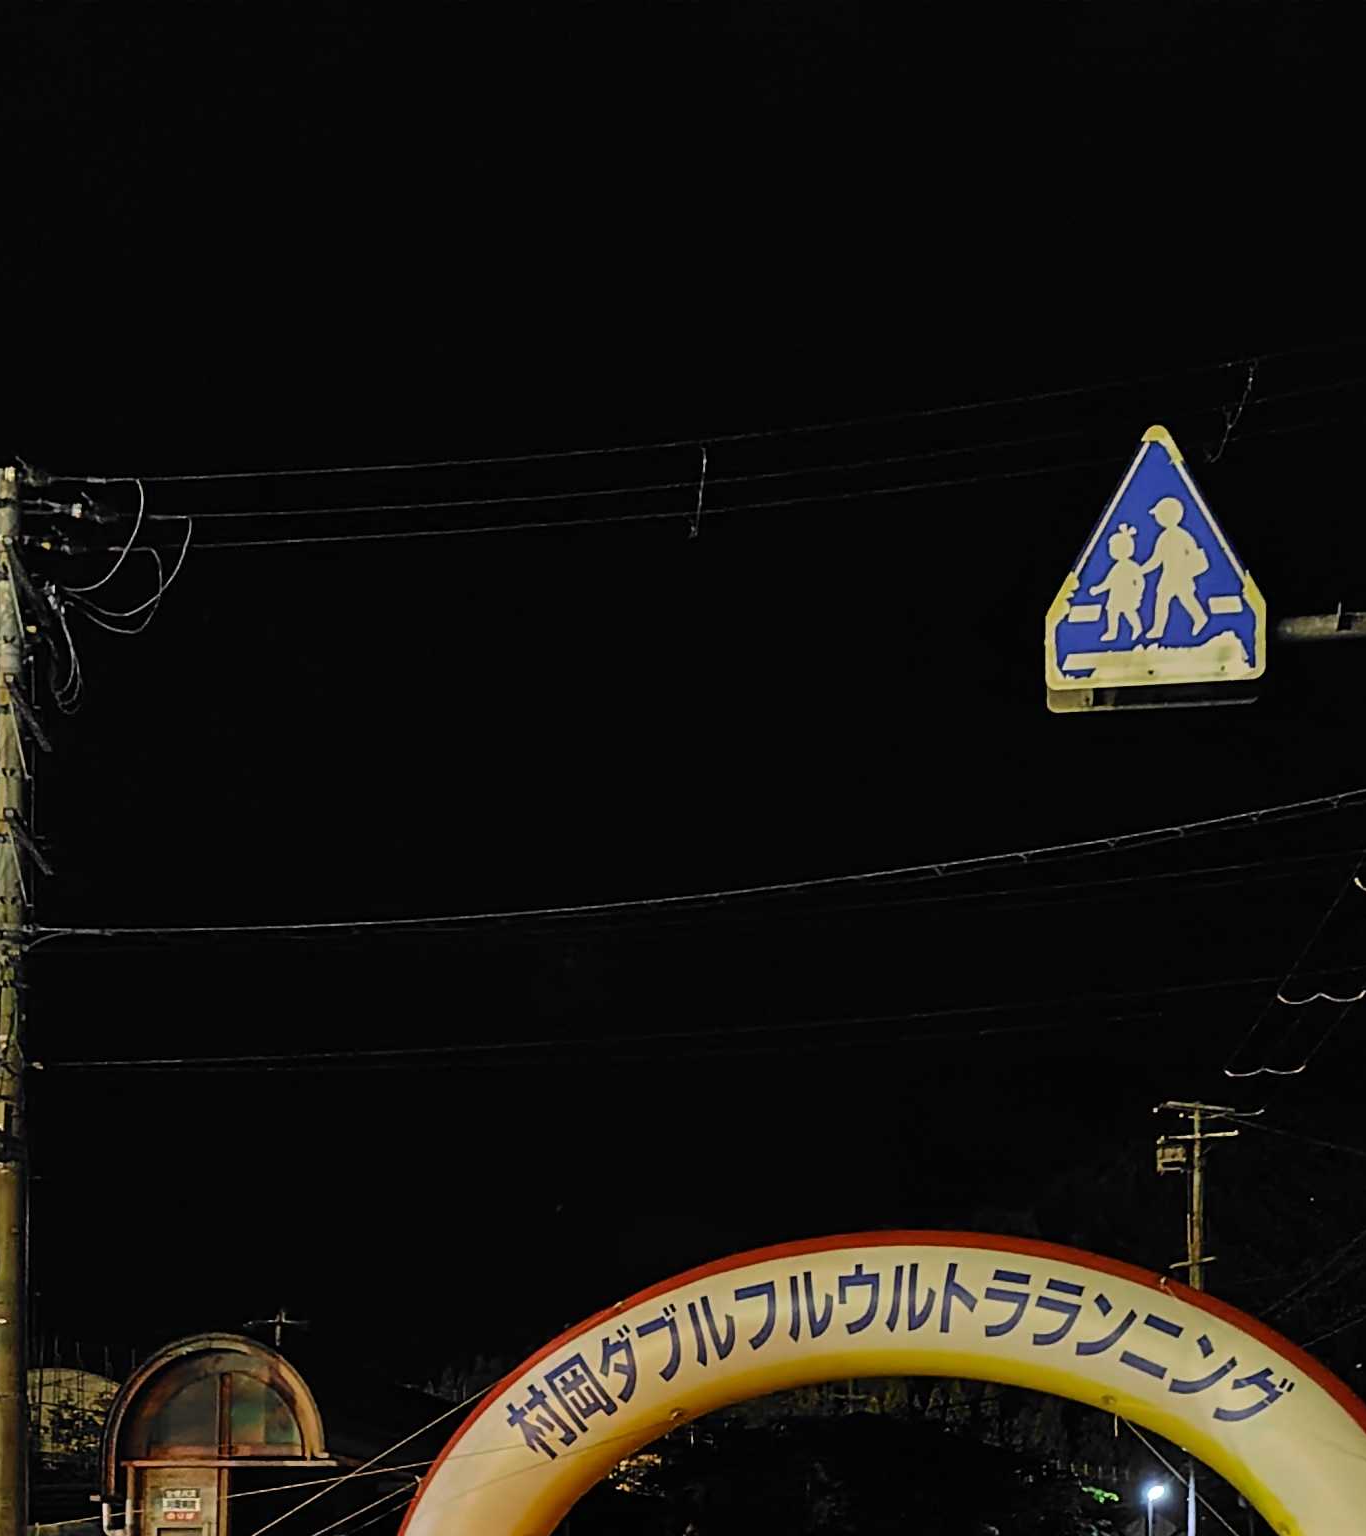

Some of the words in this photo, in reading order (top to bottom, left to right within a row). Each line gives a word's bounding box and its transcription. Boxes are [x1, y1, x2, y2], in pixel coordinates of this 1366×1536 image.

[504, 1261, 1297, 1461] 村岡ダブルフルウルトラランニング
